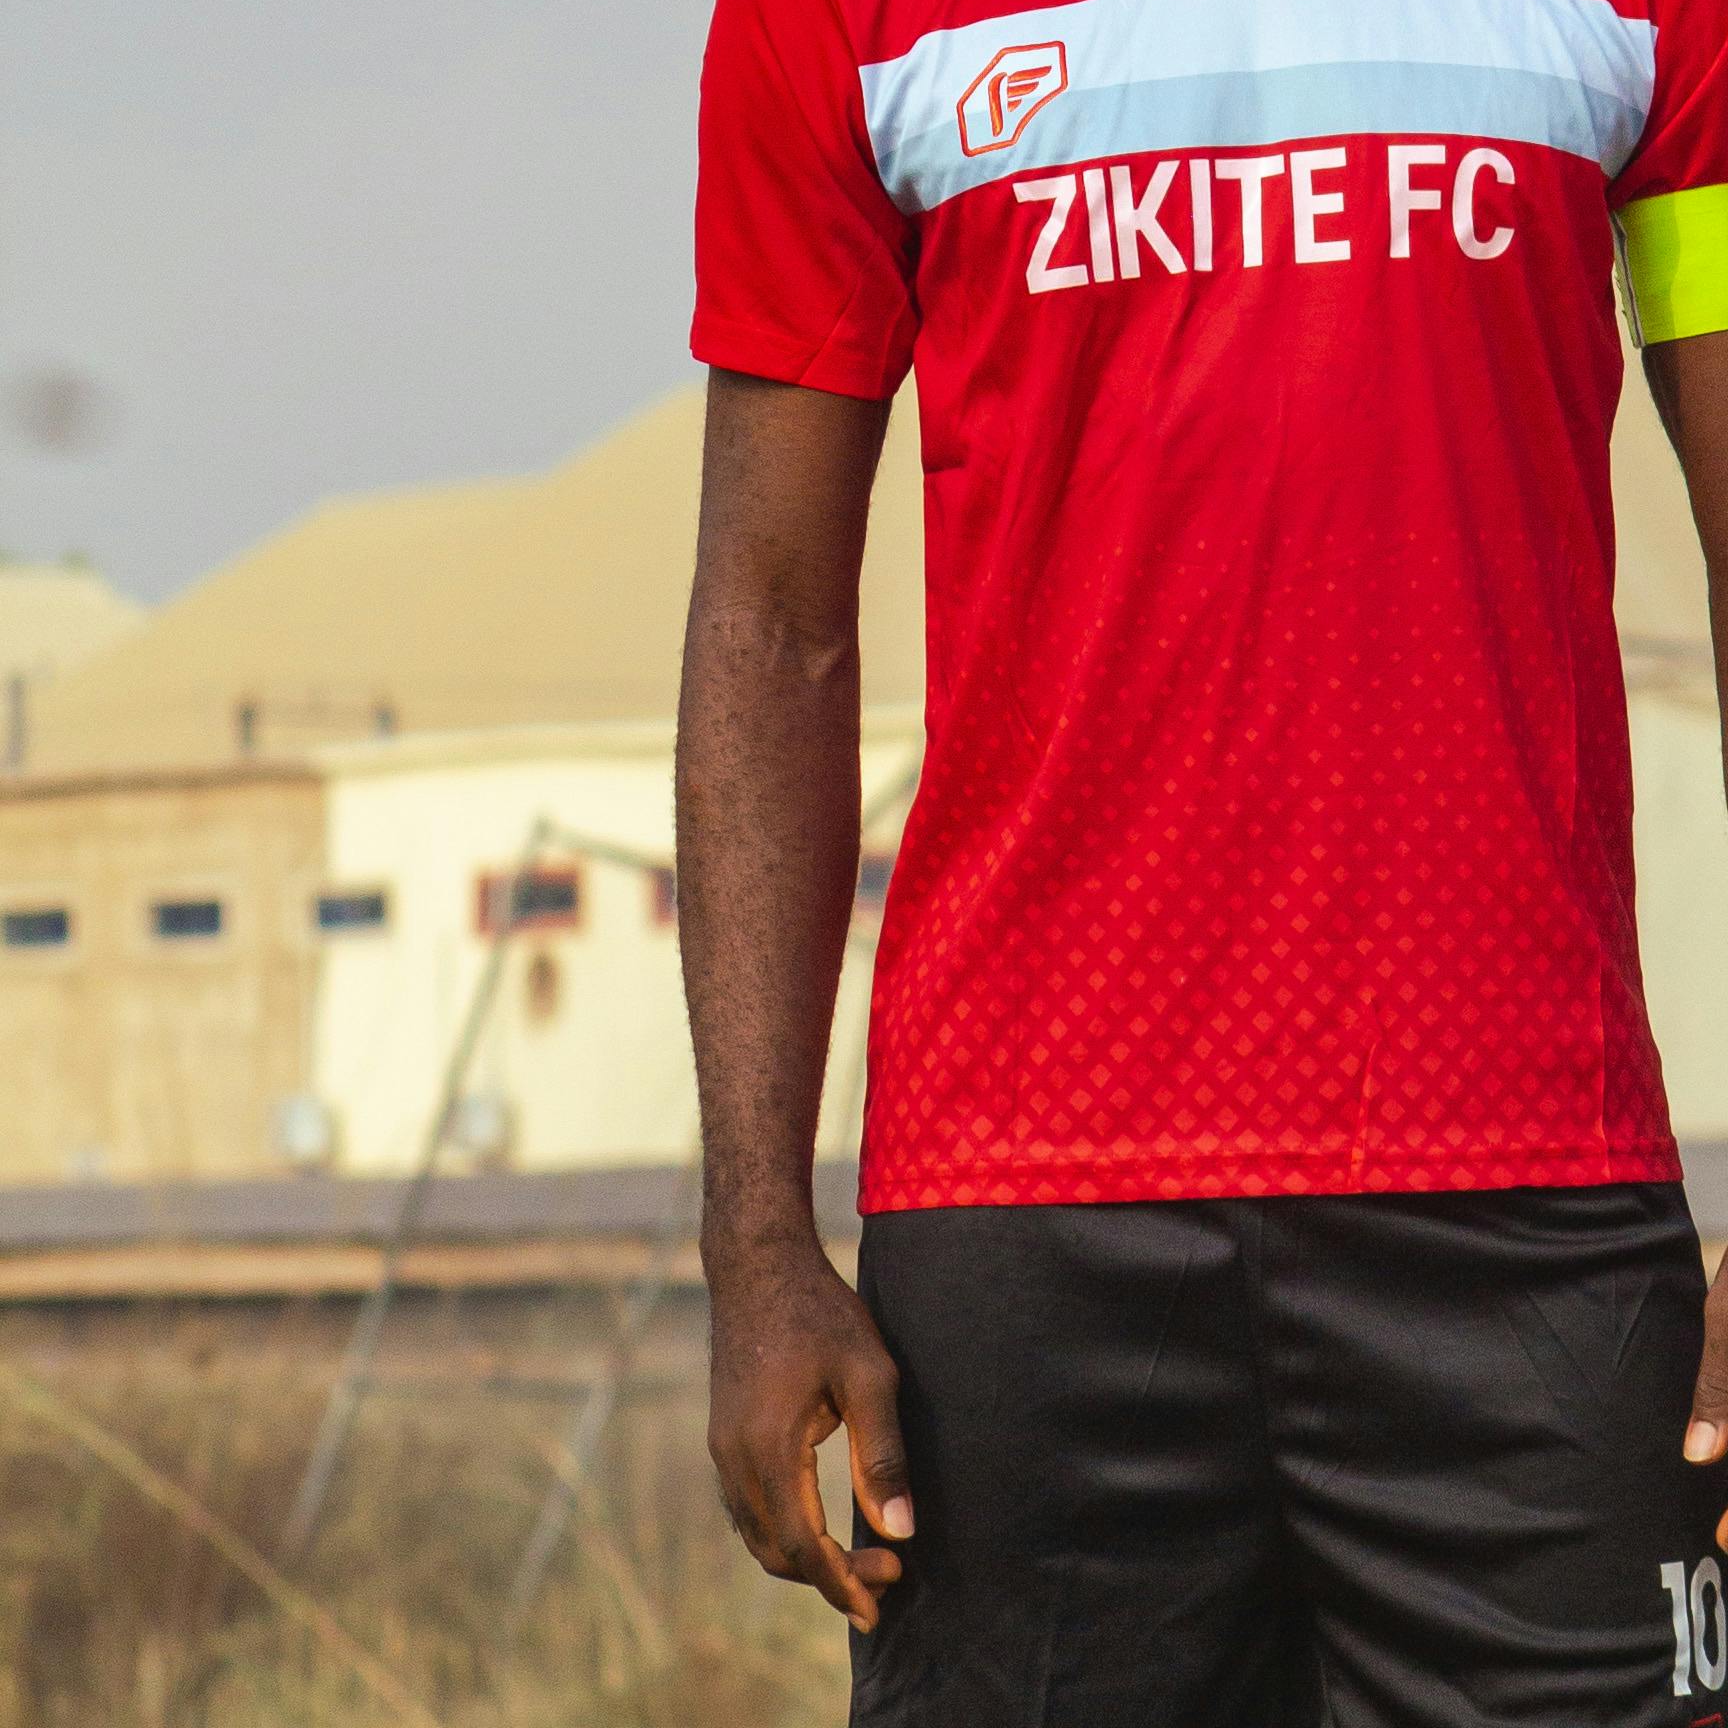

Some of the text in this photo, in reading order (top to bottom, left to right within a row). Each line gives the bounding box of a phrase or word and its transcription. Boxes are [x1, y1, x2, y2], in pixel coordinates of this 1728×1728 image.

[1012, 144, 1518, 295] ZIKITE FC
[1660, 1555, 1727, 1697] 10
